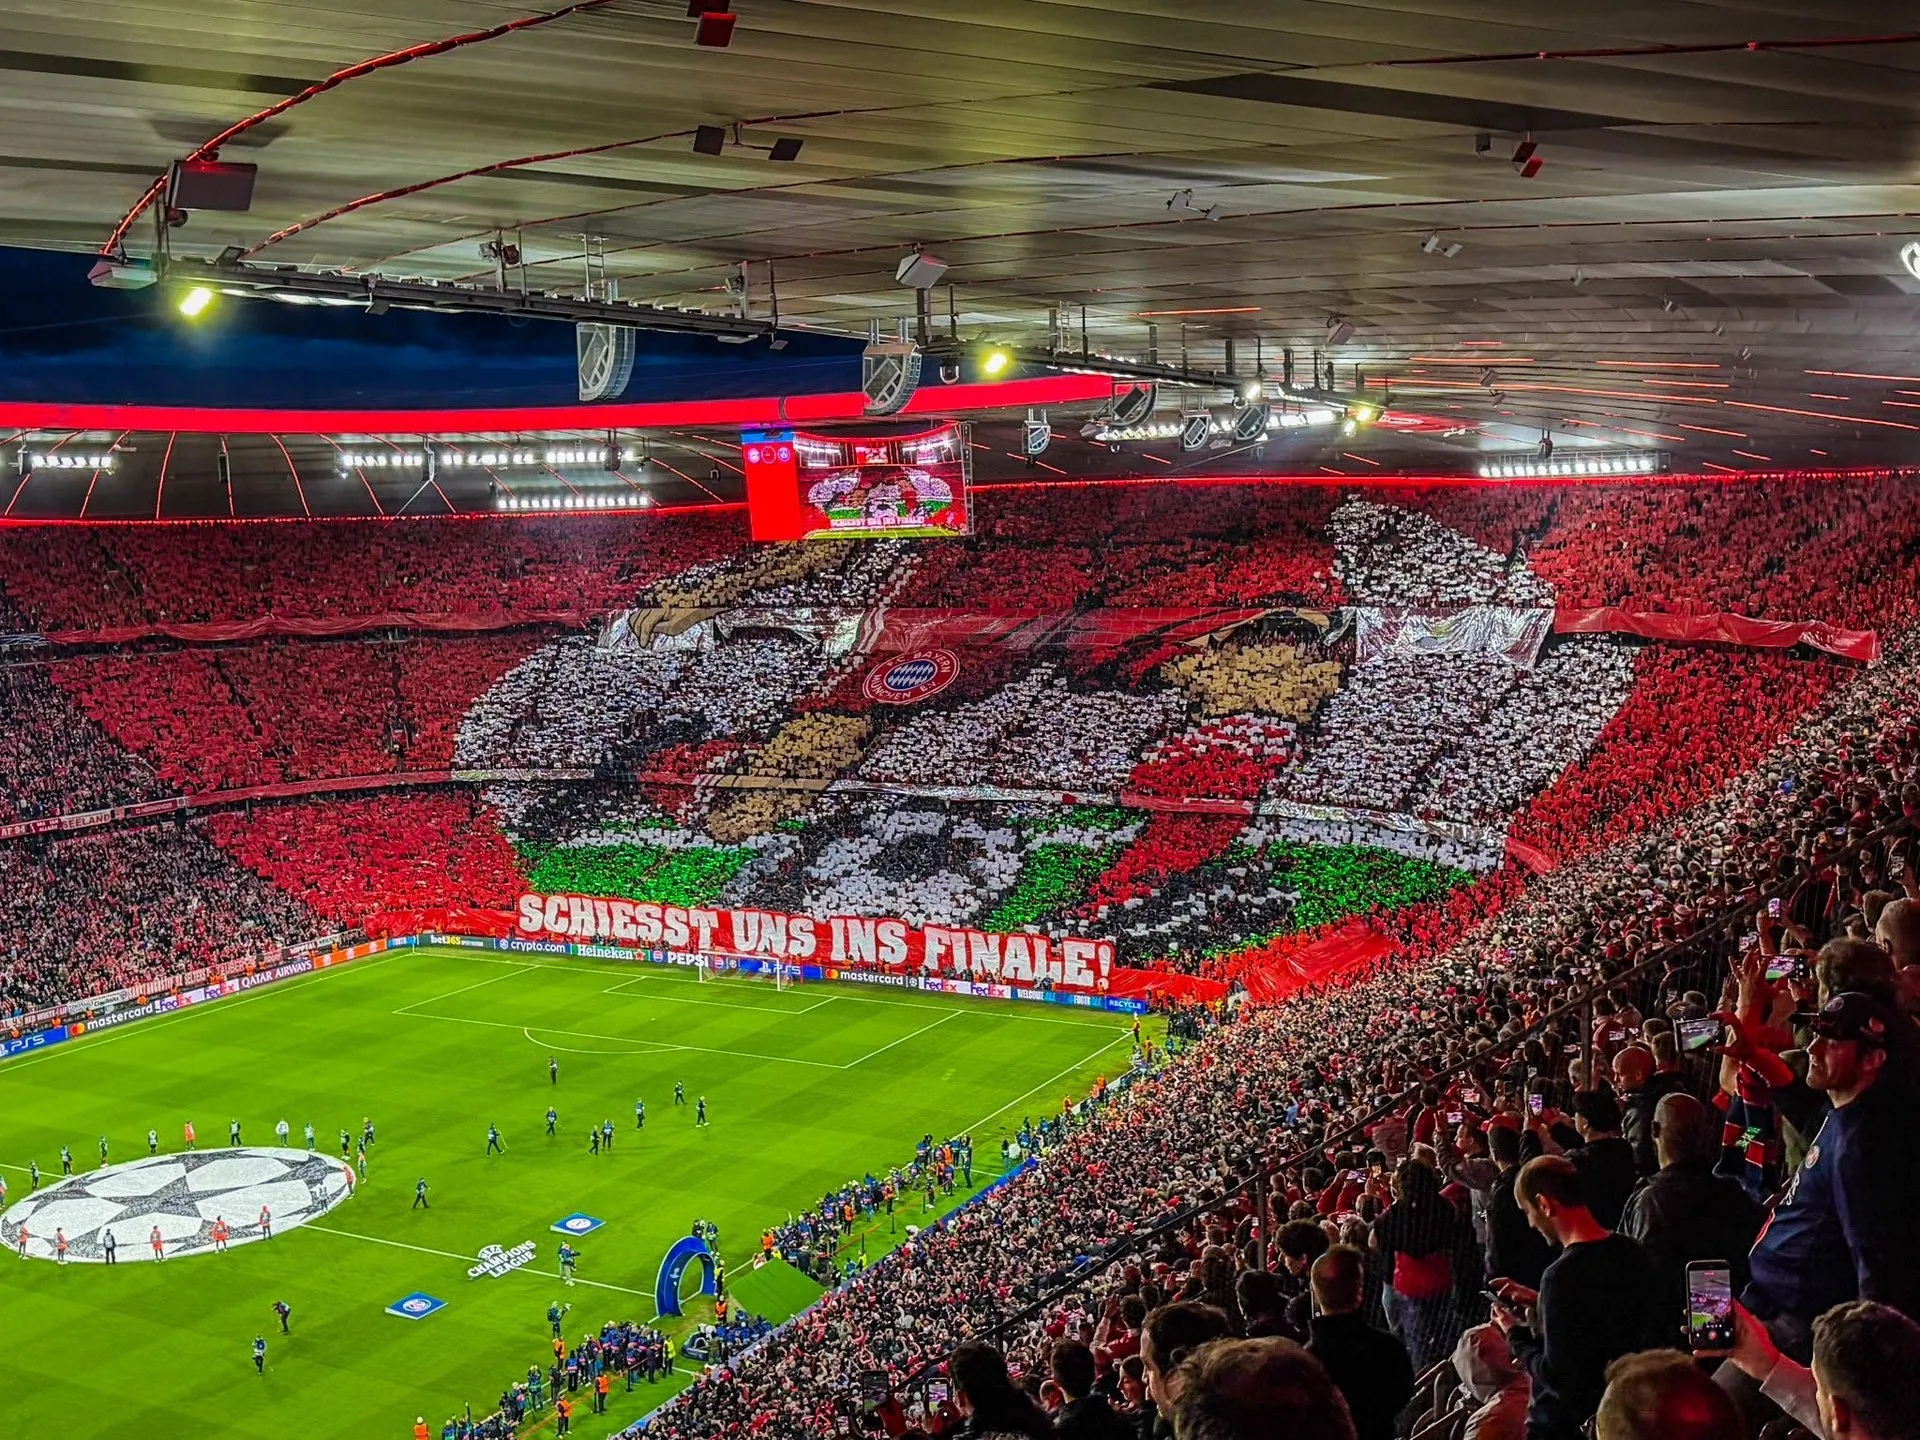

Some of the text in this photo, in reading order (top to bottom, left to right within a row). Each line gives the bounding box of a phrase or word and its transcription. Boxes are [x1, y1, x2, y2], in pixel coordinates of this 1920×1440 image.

[913, 650, 951, 673] BAYERN
[430, 934, 461, 946] bet365
[510, 940, 566, 953] crypto.com
[519, 893, 1113, 990] SCHIESST UNS INS FINALE!
[577, 943, 633, 960] Heineken
[667, 951, 709, 967] PEPSI
[241, 970, 273, 988] QATAR
[274, 960, 312, 979] AIRWAYS
[773, 963, 802, 975] PS5
[840, 970, 904, 985] mastercard
[204, 982, 235, 999] FedEx
[924, 978, 957, 992] FedEx
[970, 981, 1005, 997] FedEx
[160, 994, 193, 1011] FedEx
[1017, 988, 1045, 1001] WELCOME
[1108, 999, 1142, 1010] RECYCLE
[87, 1003, 154, 1031] mastercard
[11, 1034, 45, 1052] PS5
[467, 1240, 537, 1278] CHAMPIONS
[488, 1251, 537, 1278] LEAGUE
